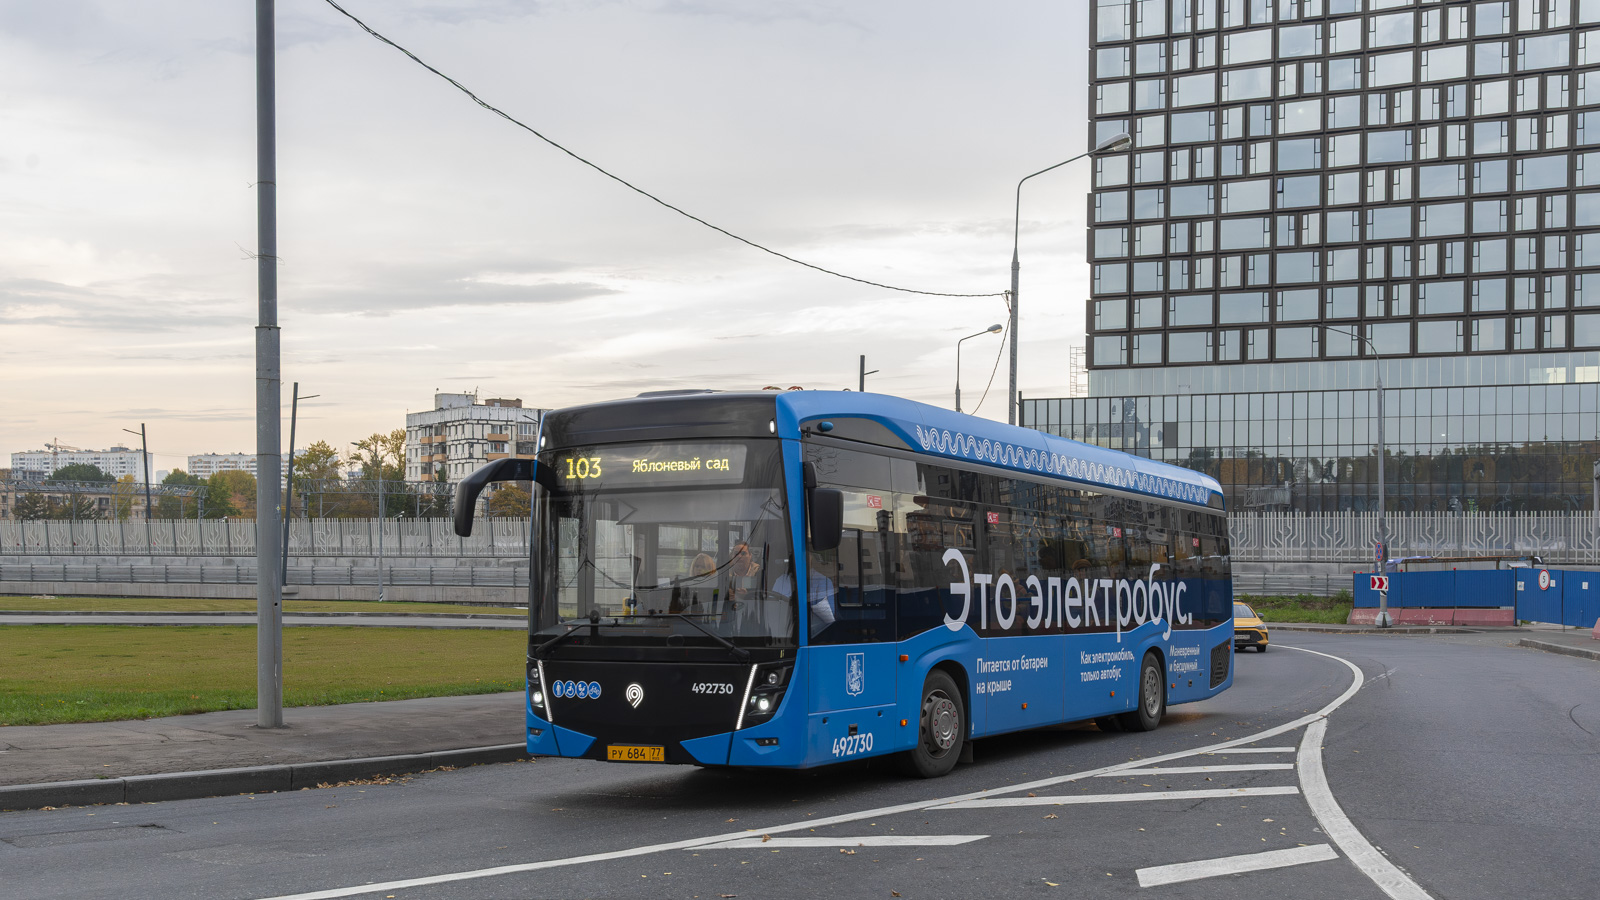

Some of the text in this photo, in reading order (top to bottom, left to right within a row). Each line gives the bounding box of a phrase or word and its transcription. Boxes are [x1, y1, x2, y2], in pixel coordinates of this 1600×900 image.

[566, 457, 602, 479] 103
[632, 457, 730, 473] Яблоневый сад
[1542, 575, 1546, 583] 5
[941, 548, 1193, 643] Это электробус.
[1080, 648, 1135, 665] Как электромобиль,
[976, 657, 1011, 674] Питается
[1011, 659, 1020, 671] от
[1080, 665, 1122, 682] только автобус
[1169, 664, 1173, 672] и
[692, 683, 734, 694] 492730
[976, 680, 1012, 696] на крыше
[832, 732, 874, 757] 492730
[627, 748, 646, 759] 684
[651, 748, 660, 756] 77
